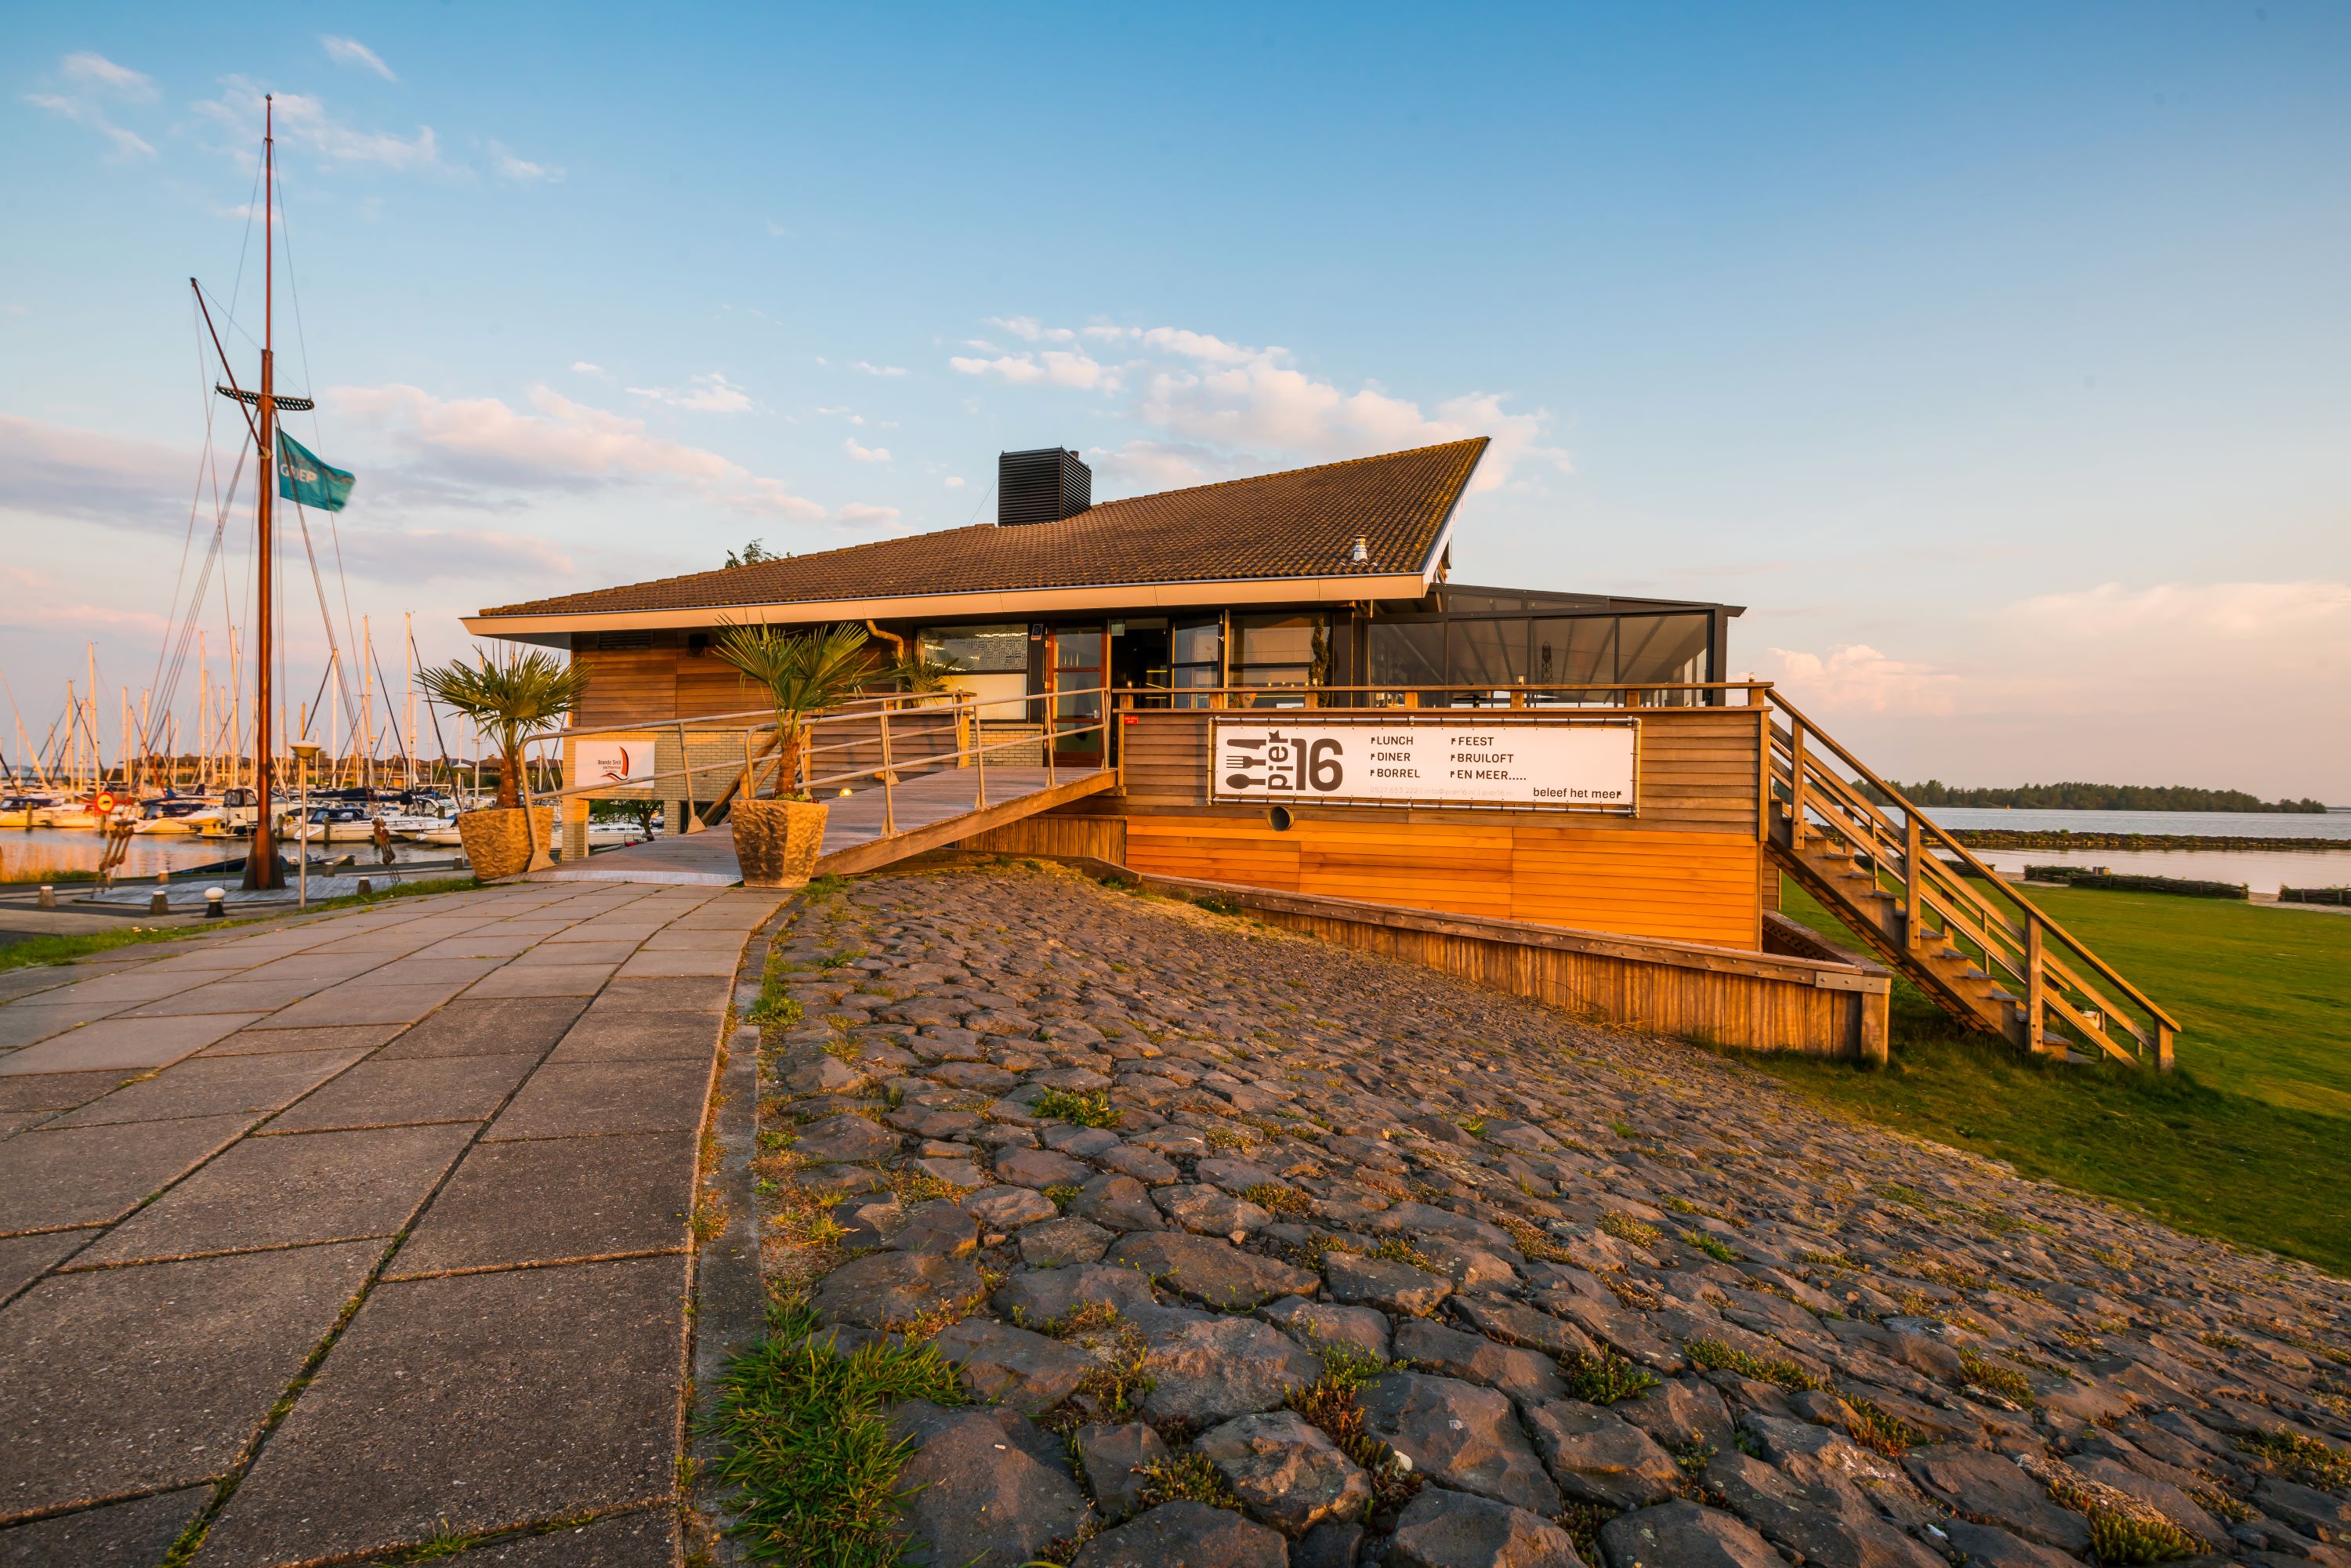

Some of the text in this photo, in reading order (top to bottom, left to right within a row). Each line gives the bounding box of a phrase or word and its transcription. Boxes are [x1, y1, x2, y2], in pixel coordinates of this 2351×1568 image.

[280, 463, 317, 483] GOEP
[1377, 736, 1414, 745] LUNCH
[1458, 737, 1494, 746] FEEST
[1268, 730, 1343, 791] pier 16
[1377, 752, 1411, 762] DINER
[1457, 753, 1514, 763] BRUILOFT
[1377, 769, 1420, 778] BORREL
[1457, 770, 1473, 780] EN
[1533, 788, 1622, 799] beleef het meer
